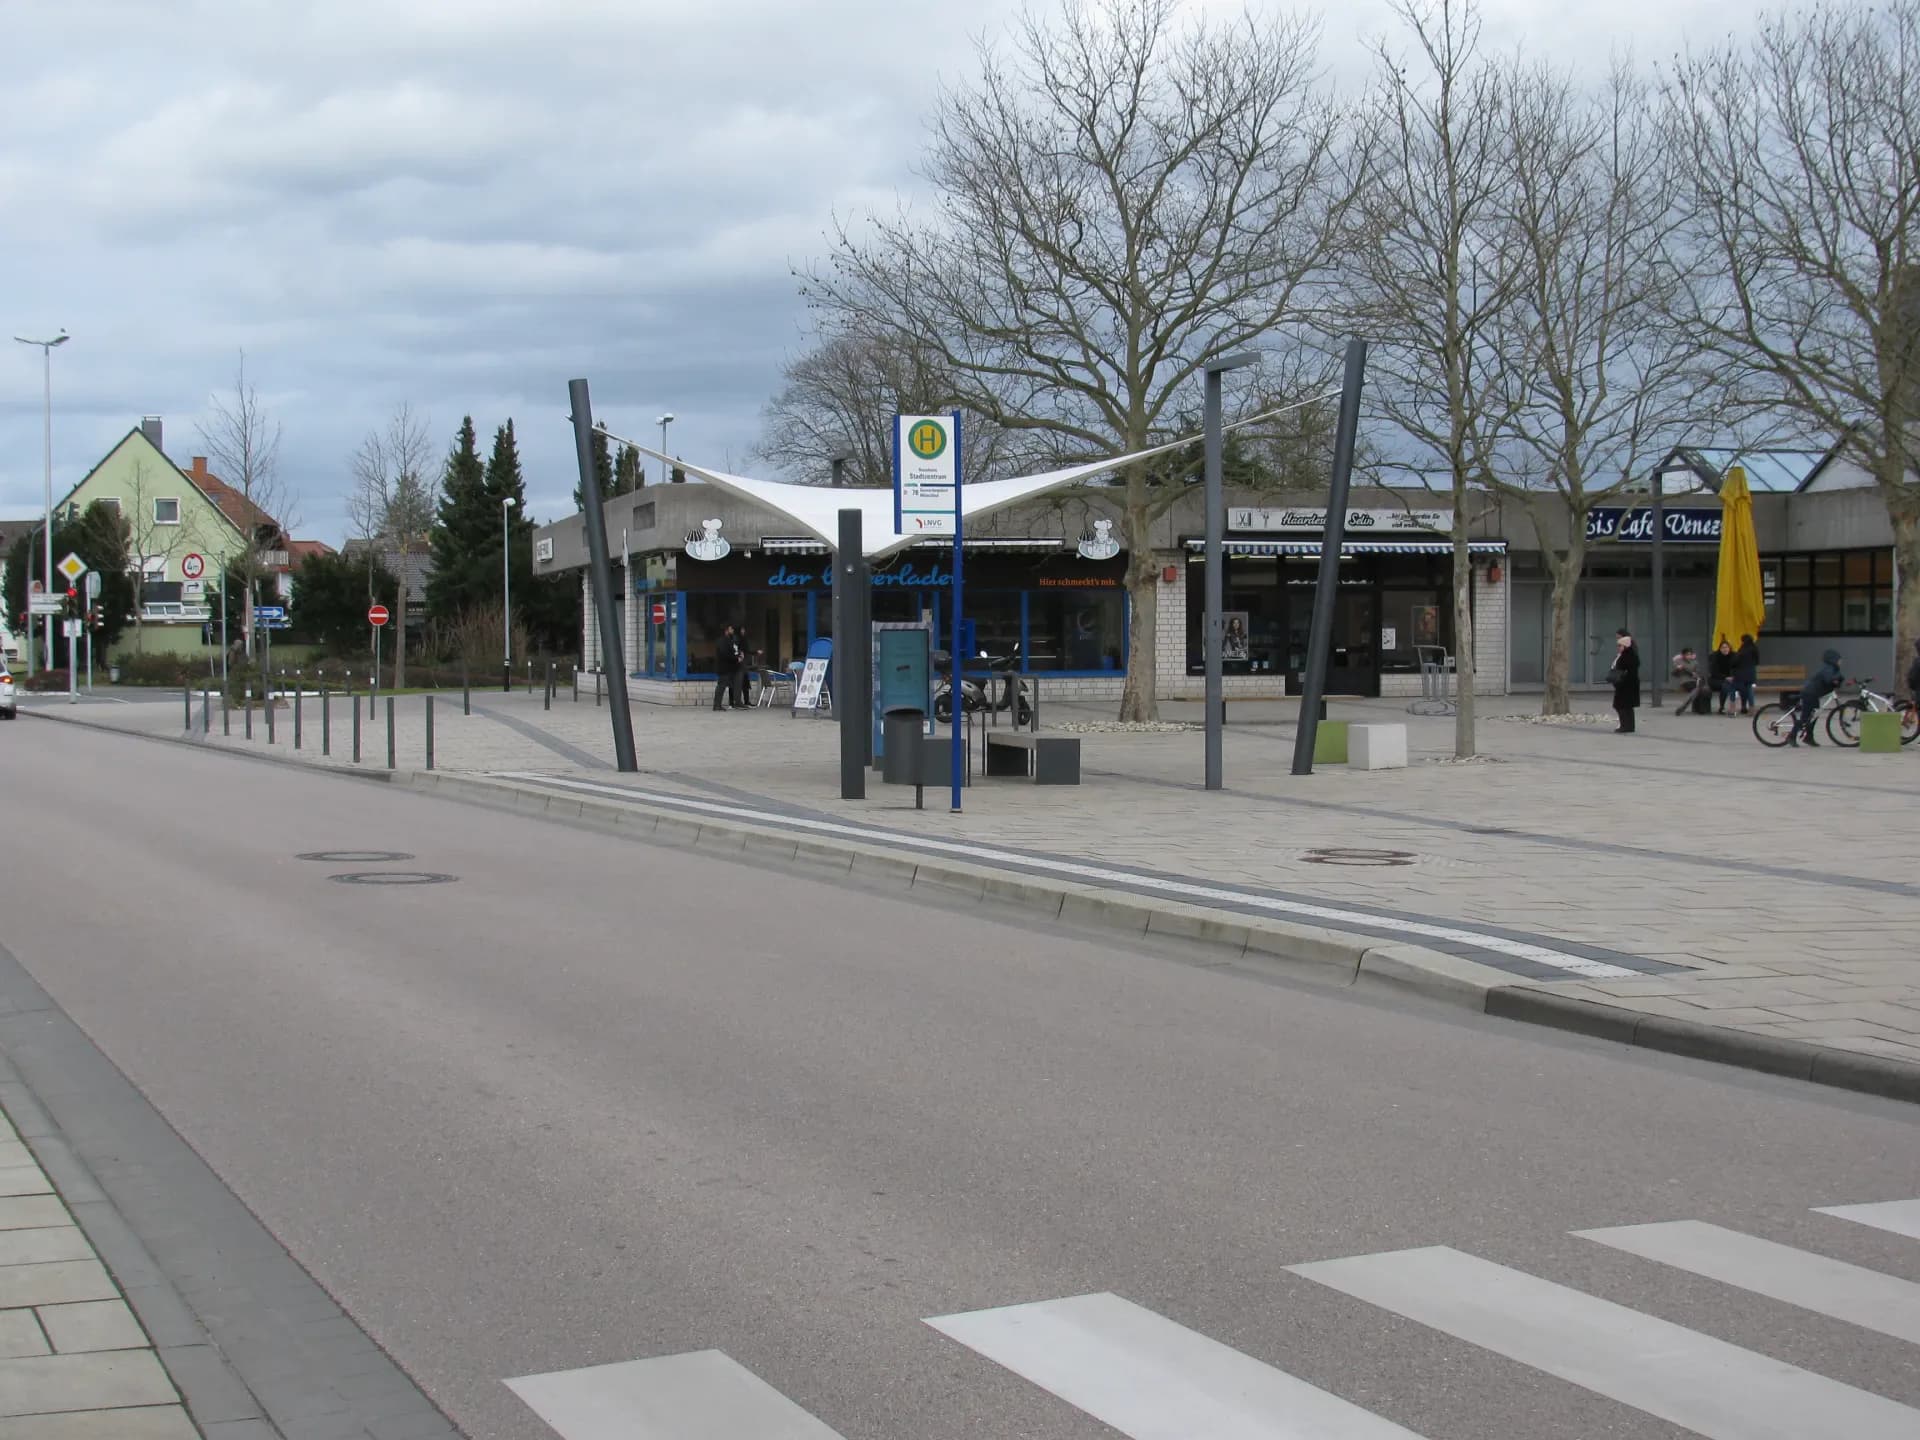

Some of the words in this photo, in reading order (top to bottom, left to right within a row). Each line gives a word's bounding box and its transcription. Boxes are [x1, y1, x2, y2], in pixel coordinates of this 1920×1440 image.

[920, 428, 935, 451] H
[1281, 511, 1328, 526] Haardesi
[1348, 512, 1375, 526] Selin
[1665, 513, 1722, 535] Venez
[768, 564, 813, 586] der
